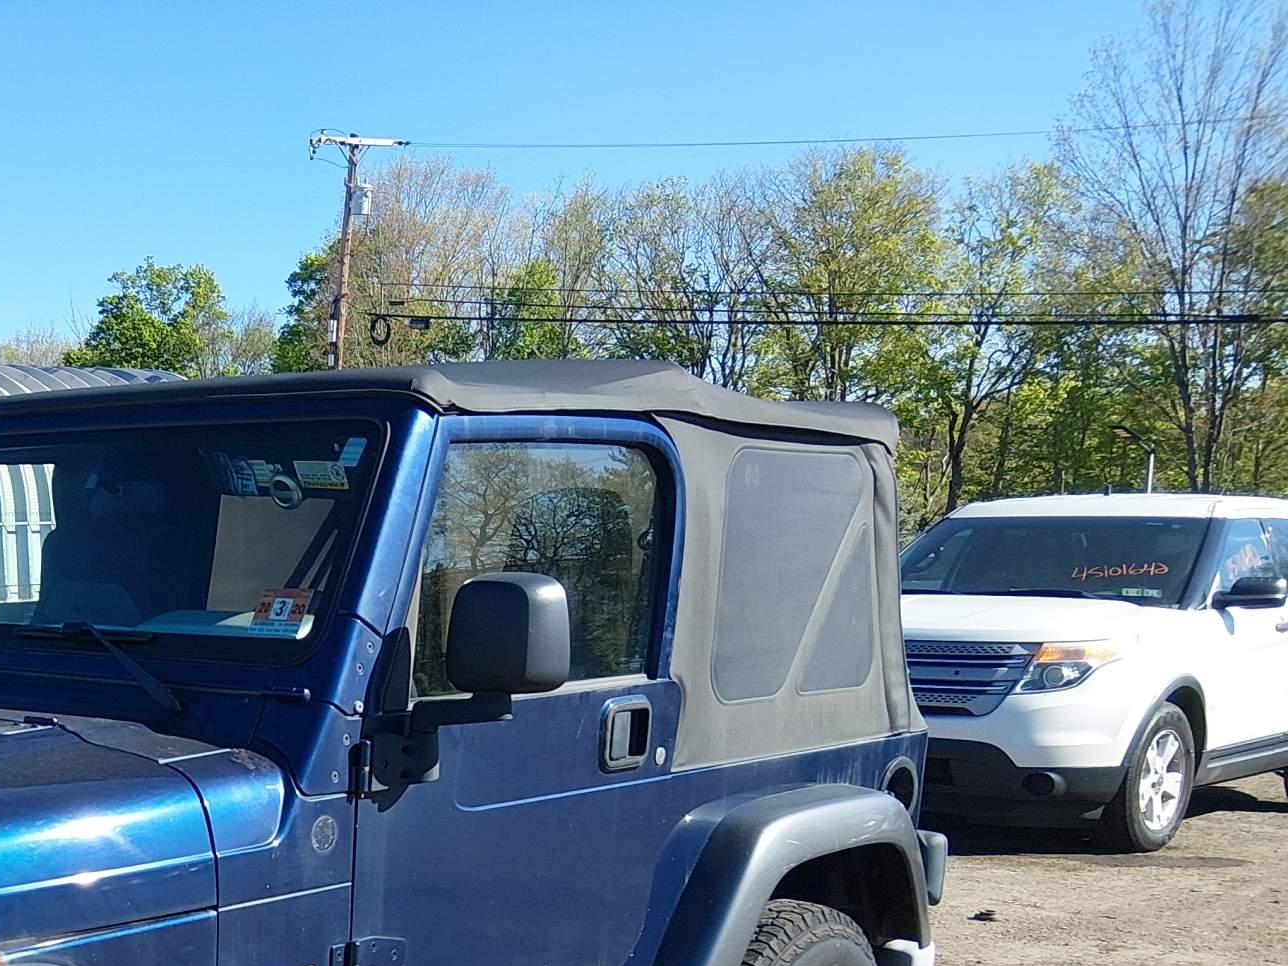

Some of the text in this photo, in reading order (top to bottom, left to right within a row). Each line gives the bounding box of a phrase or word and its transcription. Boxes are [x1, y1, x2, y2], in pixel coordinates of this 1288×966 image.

[1072, 562, 1169, 581] 45101642
[275, 600, 287, 617] 3
[291, 603, 306, 615] 20
